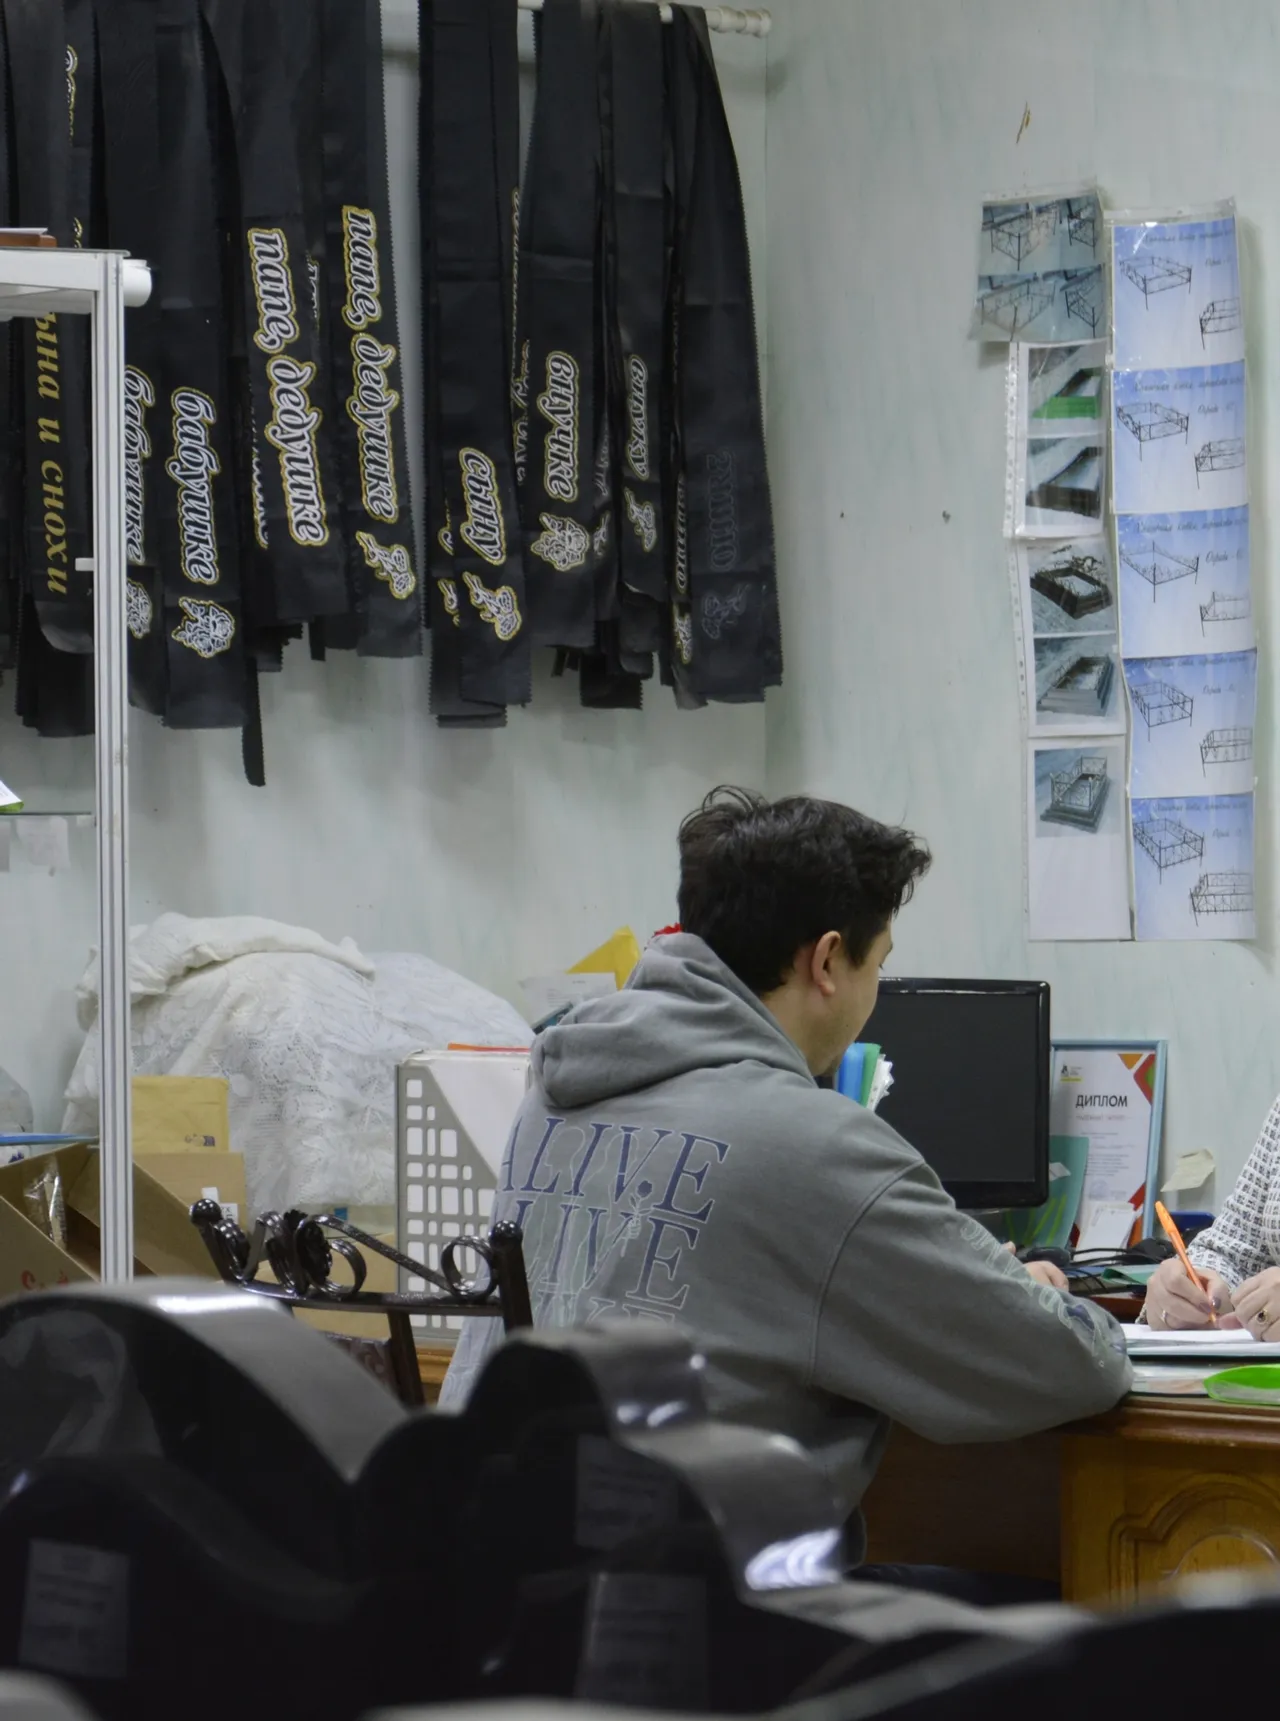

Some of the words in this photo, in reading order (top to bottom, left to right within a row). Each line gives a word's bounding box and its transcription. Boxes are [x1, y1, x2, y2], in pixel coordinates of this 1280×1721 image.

[247, 227, 300, 354] папе,
[341, 205, 382, 330] папе,
[34, 312, 60, 400] ына
[124, 365, 155, 565] бабушке
[166, 387, 220, 585] бабушке
[264, 354, 330, 546] дедушке
[346, 332, 399, 523] дедушке
[536, 351, 579, 502] внучке
[41, 460, 68, 595] снохи
[459, 447, 506, 566] сыну
[1075, 1095, 1128, 1109] ДИПЛОМ
